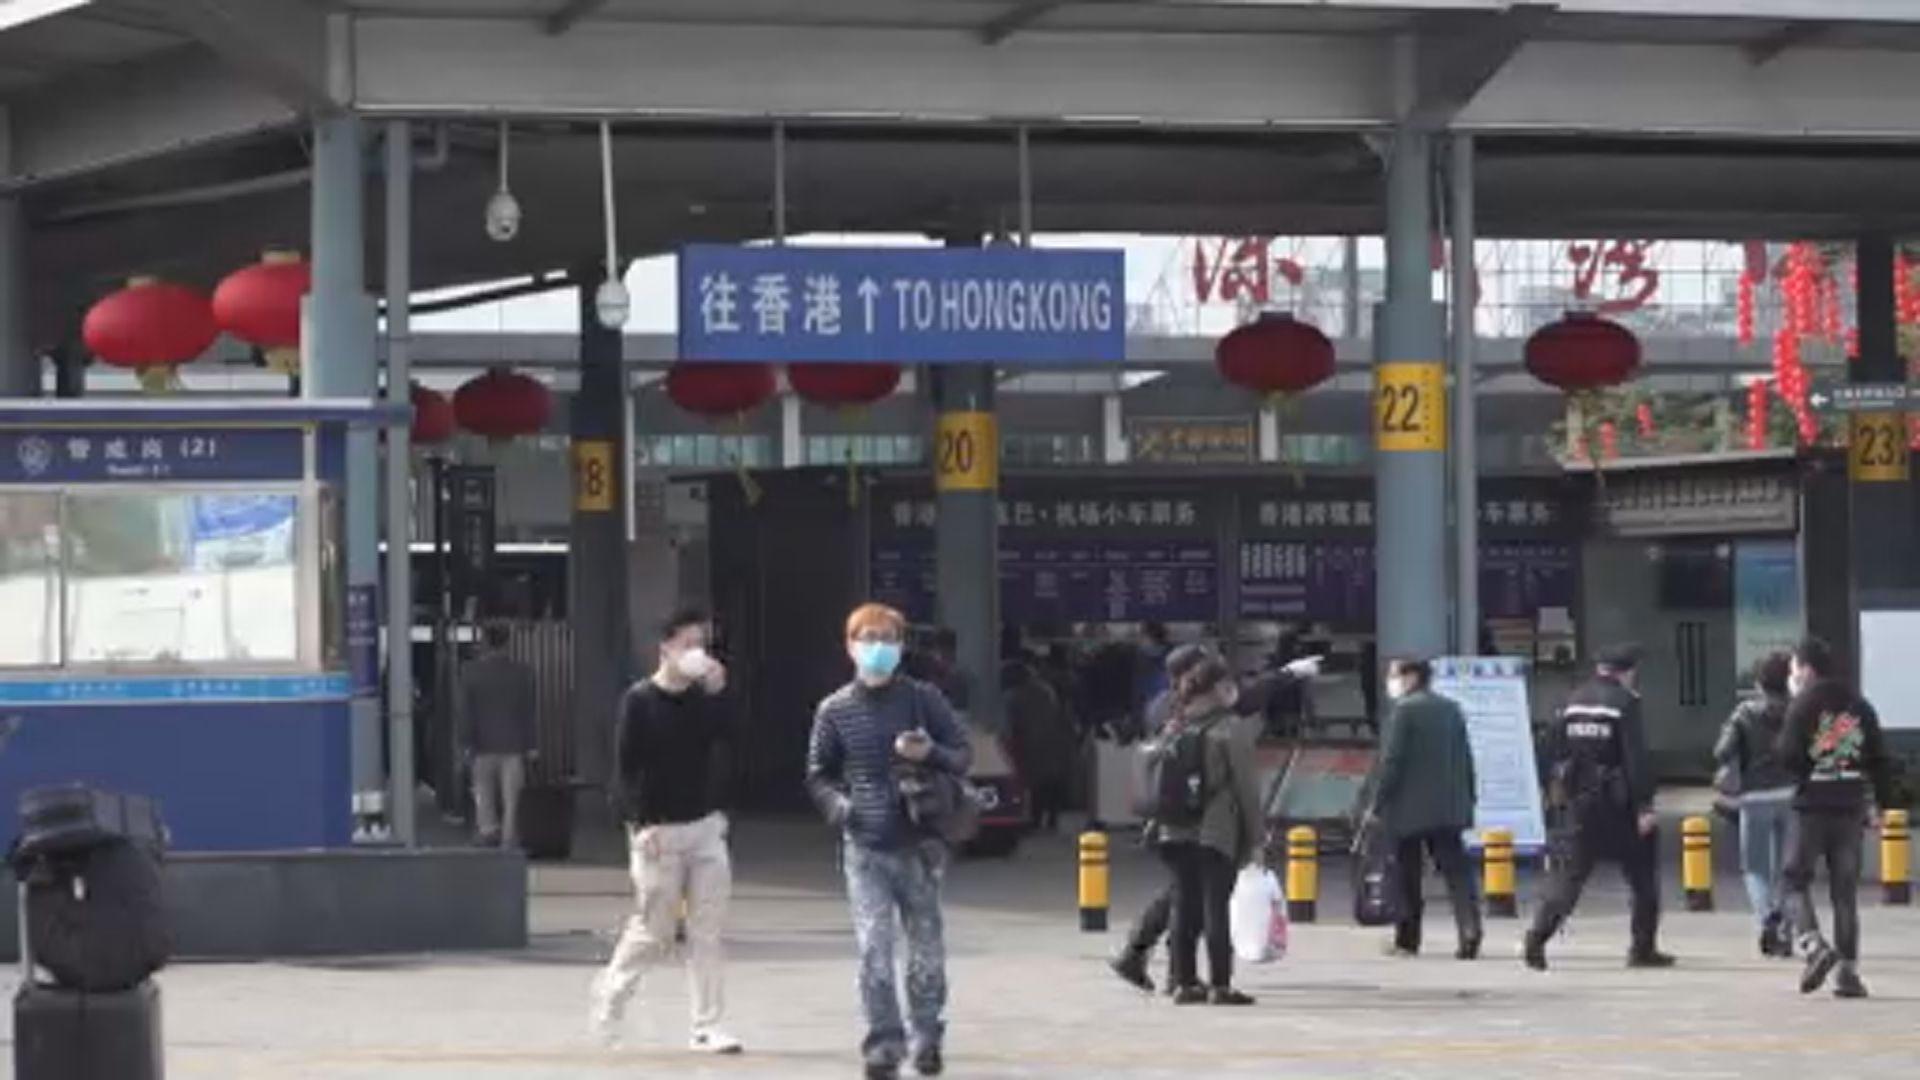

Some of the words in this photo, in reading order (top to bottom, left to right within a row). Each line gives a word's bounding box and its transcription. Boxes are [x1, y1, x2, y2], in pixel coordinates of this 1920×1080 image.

[700, 274, 842, 335] 往香港
[894, 279, 933, 331] TO
[941, 278, 1113, 332] HONGKONG
[1383, 384, 1421, 432] 22
[941, 430, 972, 474] 20
[1859, 424, 1895, 466] 23
